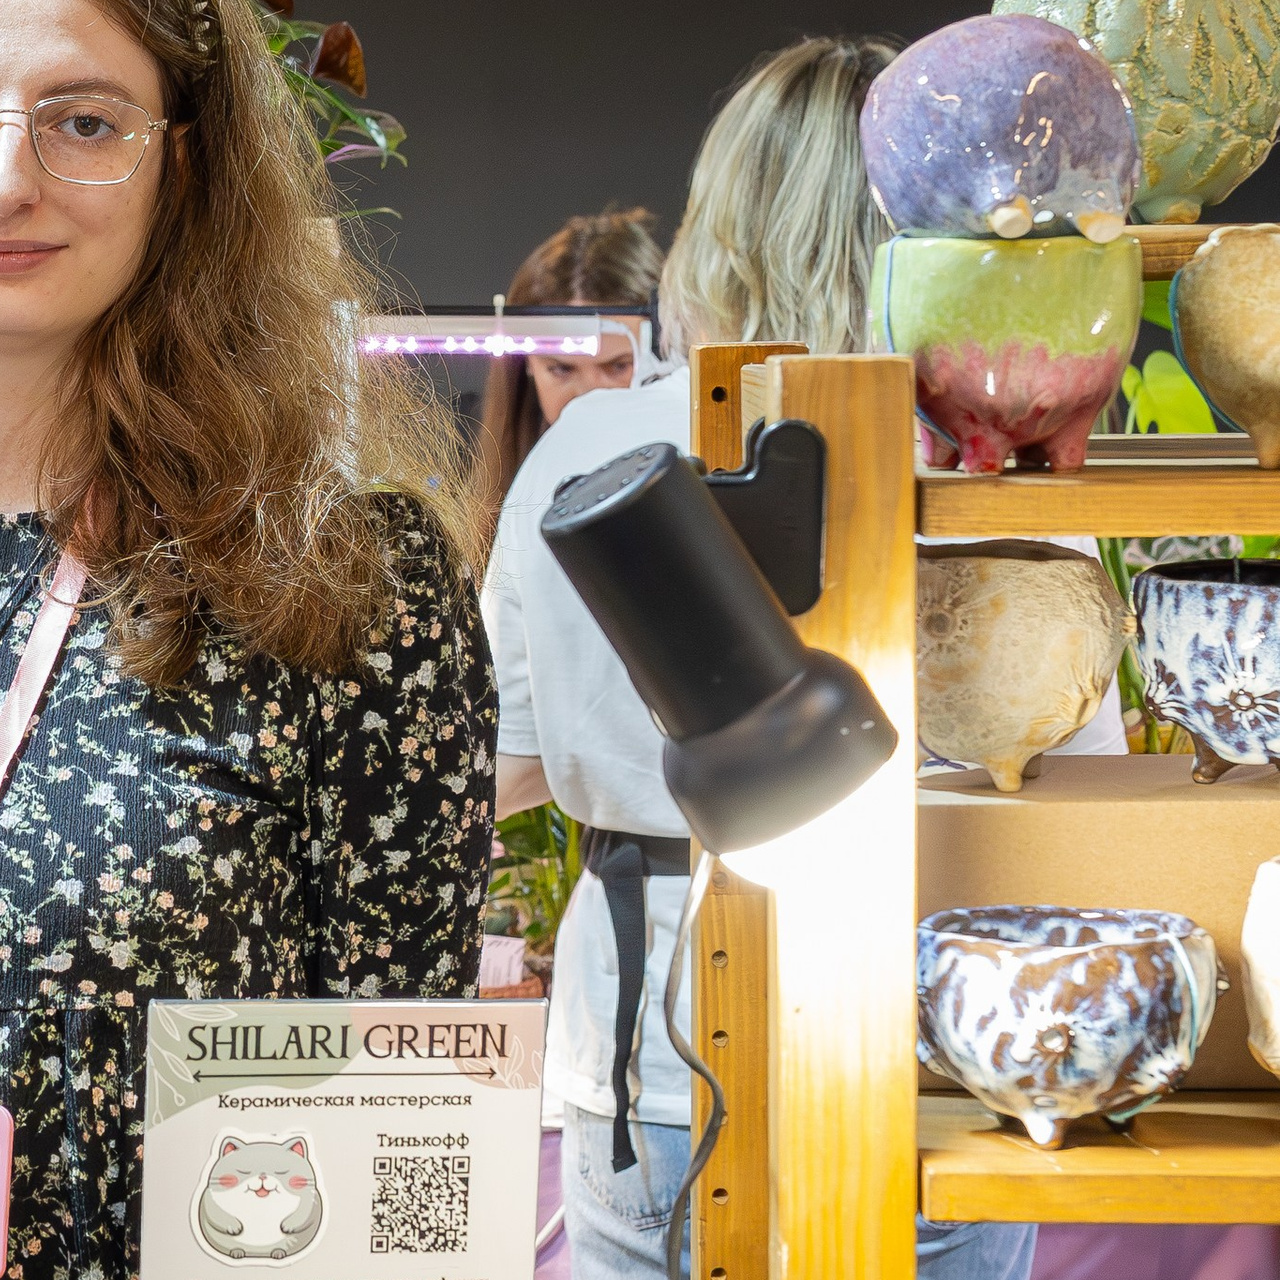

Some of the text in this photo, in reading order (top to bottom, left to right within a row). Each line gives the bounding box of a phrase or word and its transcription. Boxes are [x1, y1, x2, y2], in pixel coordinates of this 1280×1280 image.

[186, 1023, 509, 1061] SHILARI GREEN
[218, 1094, 472, 1111] Керамическая мастерская
[377, 1132, 470, 1150] Тинькофф
